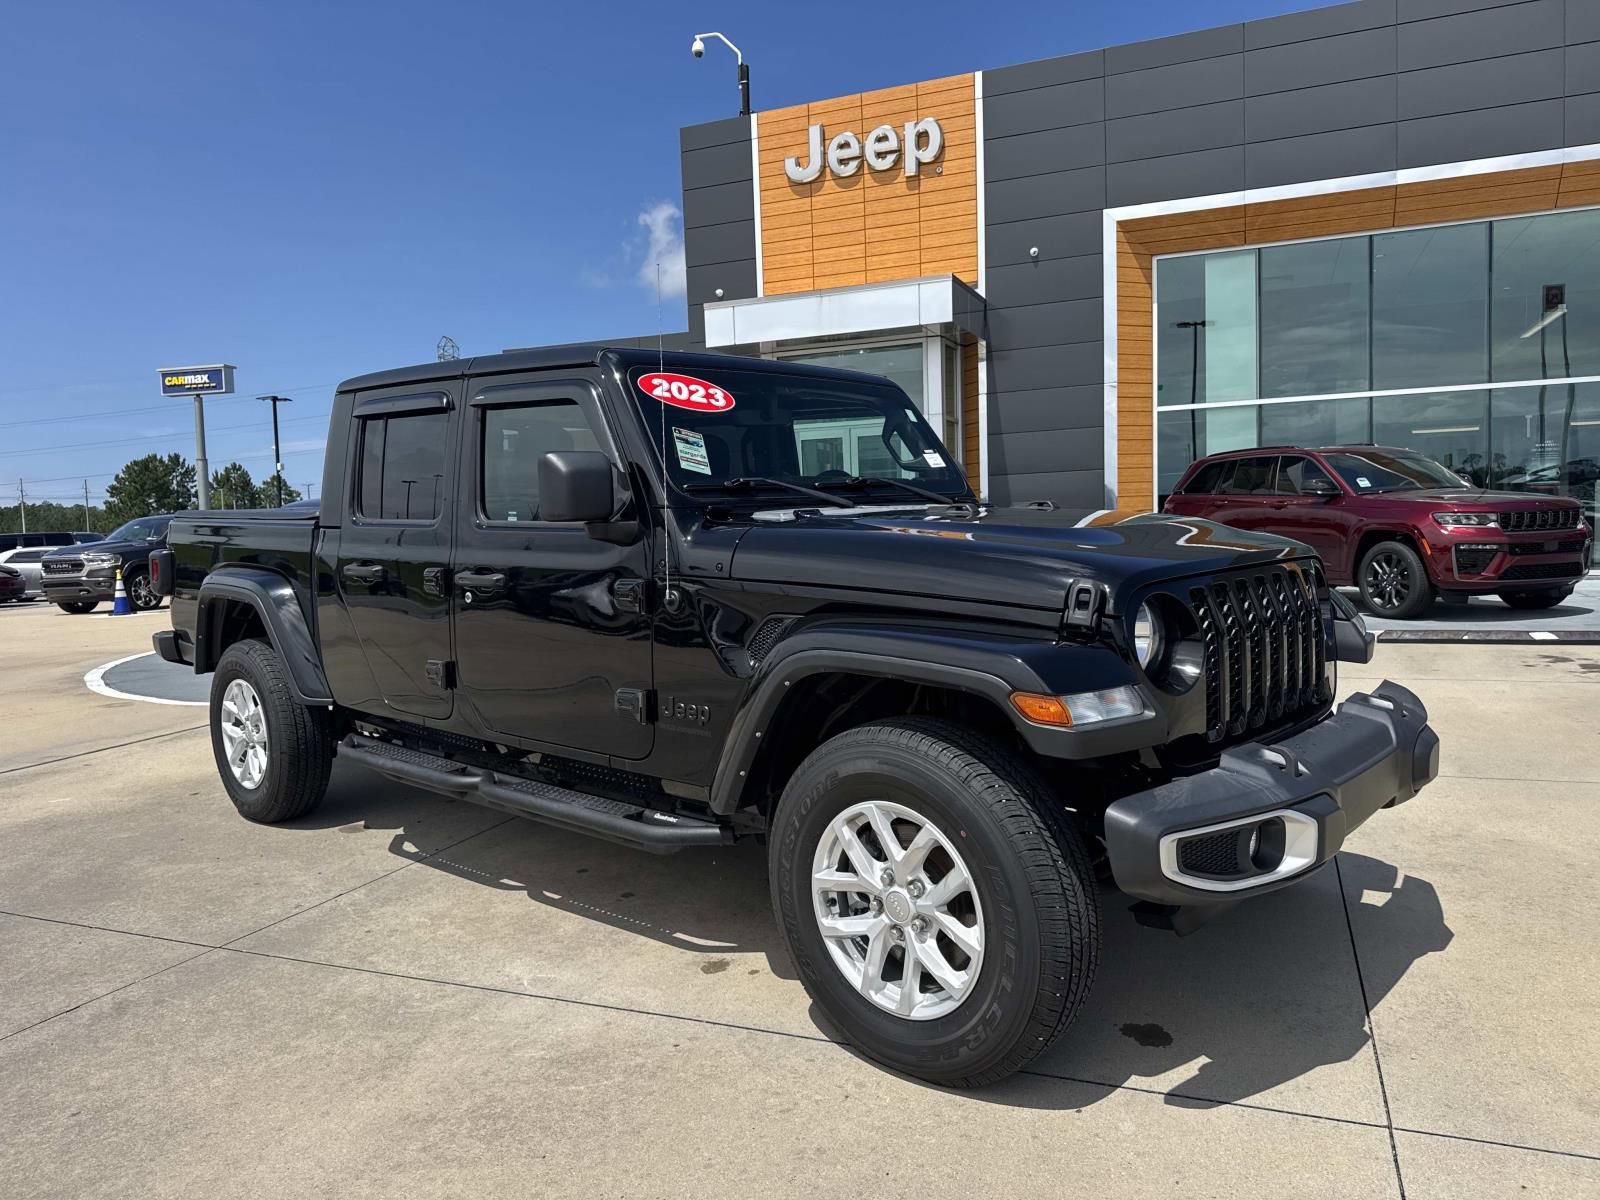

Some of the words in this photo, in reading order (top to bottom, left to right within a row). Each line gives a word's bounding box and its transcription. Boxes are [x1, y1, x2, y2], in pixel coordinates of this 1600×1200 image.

[784, 116, 944, 184] Jeep
[164, 374, 210, 386] CARmax
[651, 378, 727, 407] 2023
[662, 696, 711, 726] Jeep
